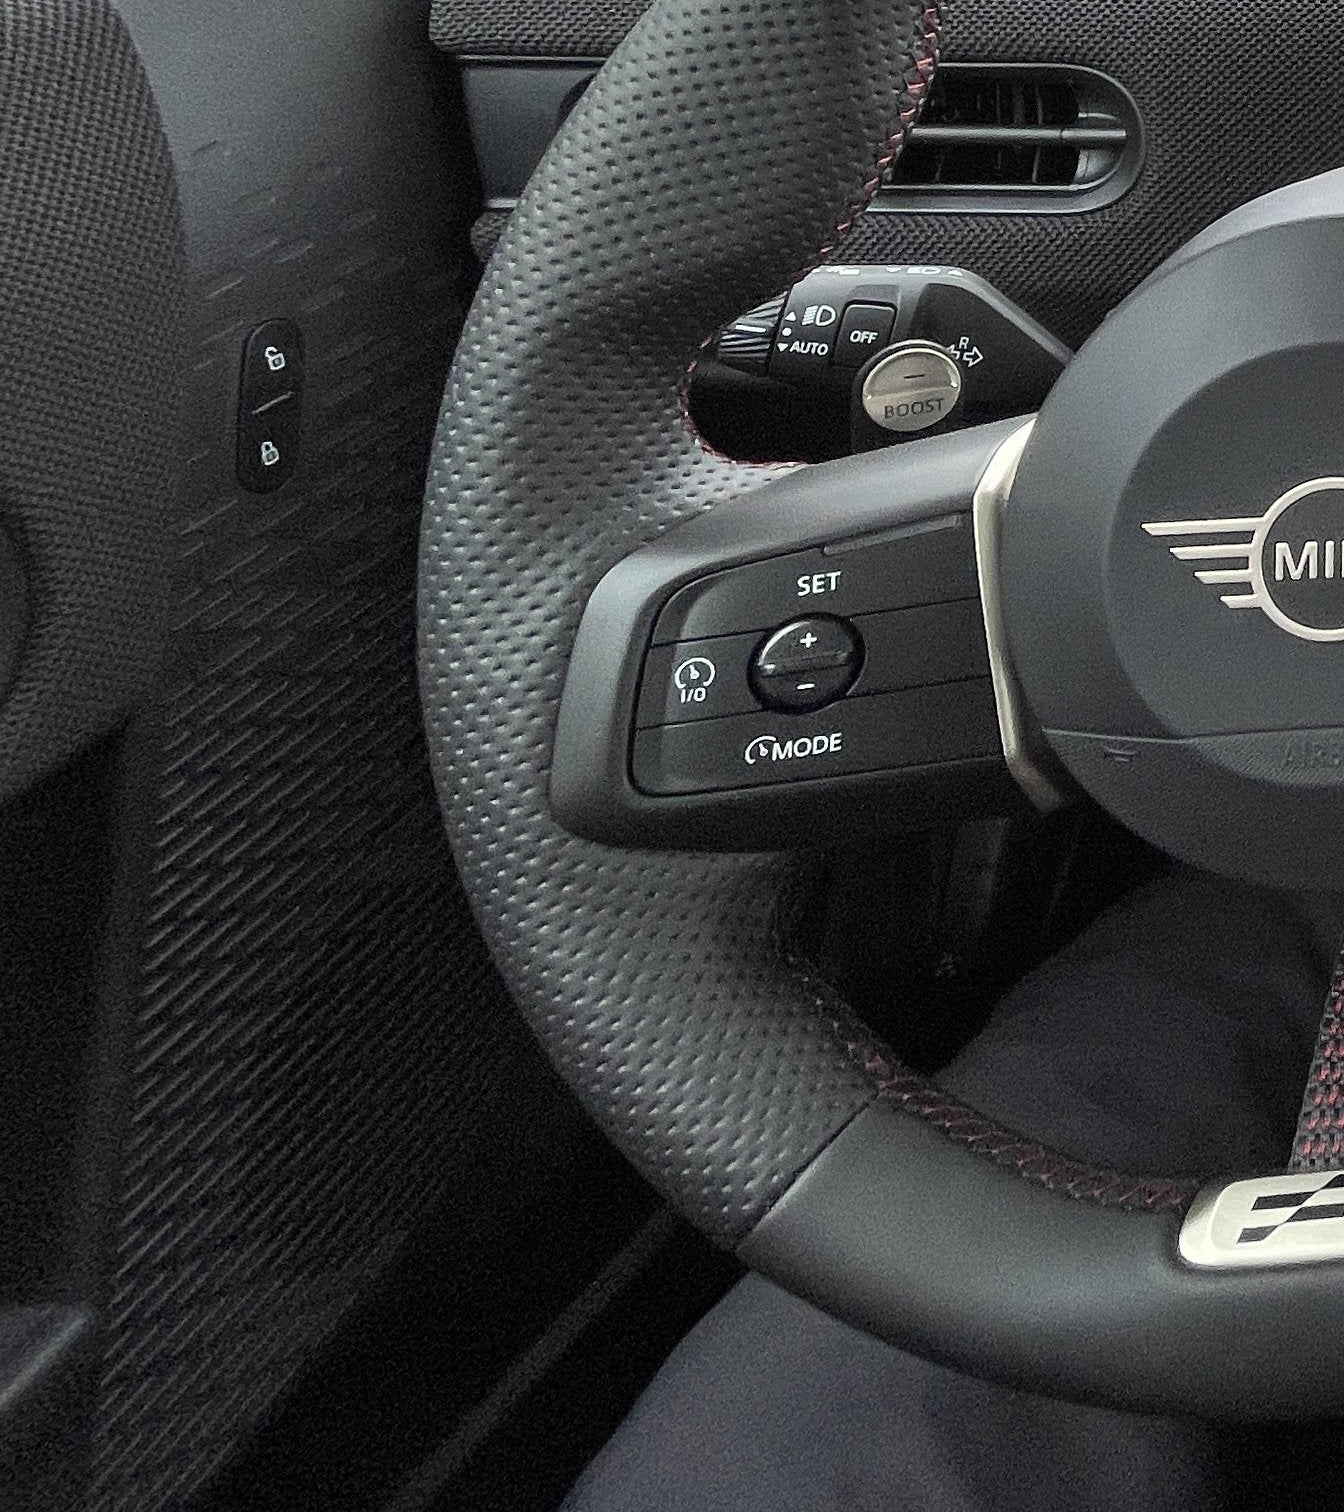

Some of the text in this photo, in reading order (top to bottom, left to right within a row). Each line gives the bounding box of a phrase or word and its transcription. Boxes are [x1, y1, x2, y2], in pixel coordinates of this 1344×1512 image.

[849, 330, 879, 344] OFF
[958, 336, 969, 350] R
[789, 341, 829, 357] AUTO
[883, 396, 947, 420] BOOST
[796, 571, 842, 597] SET
[771, 733, 843, 762] MODE
